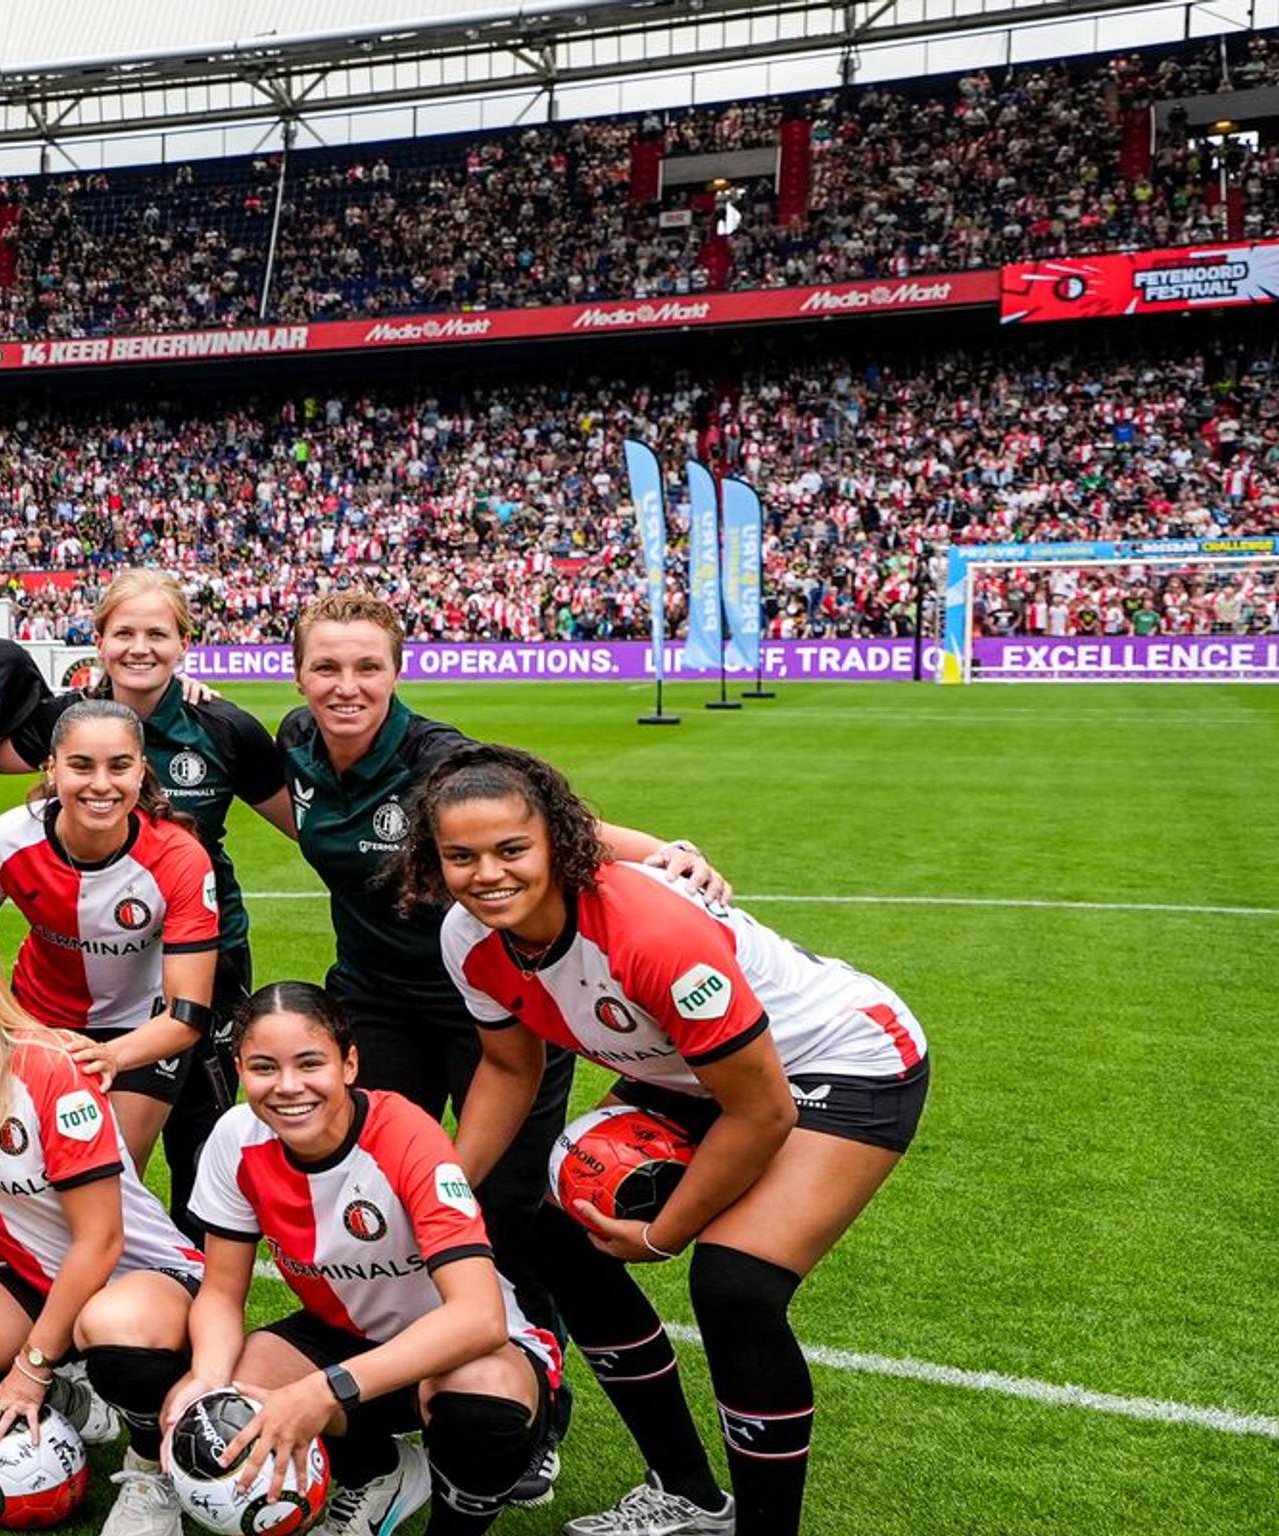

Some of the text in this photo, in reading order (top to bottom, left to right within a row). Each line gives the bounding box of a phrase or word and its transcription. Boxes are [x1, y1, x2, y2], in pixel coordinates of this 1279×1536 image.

[1134, 263, 1247, 287] FEYENOORD
[800, 281, 953, 311] Media Markt
[1144, 281, 1238, 301] FESTIVAL
[572, 302, 710, 328] Media Markt
[365, 317, 491, 342] Media Markt
[21, 326, 309, 365] 14 KEER BEKERWINNAAR
[177, 650, 294, 674] ELLENCE
[420, 649, 619, 674] OPERATIONS.
[796, 647, 912, 672] TRADE
[1002, 643, 1254, 671] EXCELLENCE
[678, 975, 723, 1012] TOTO
[59, 1104, 99, 1129] TOTO
